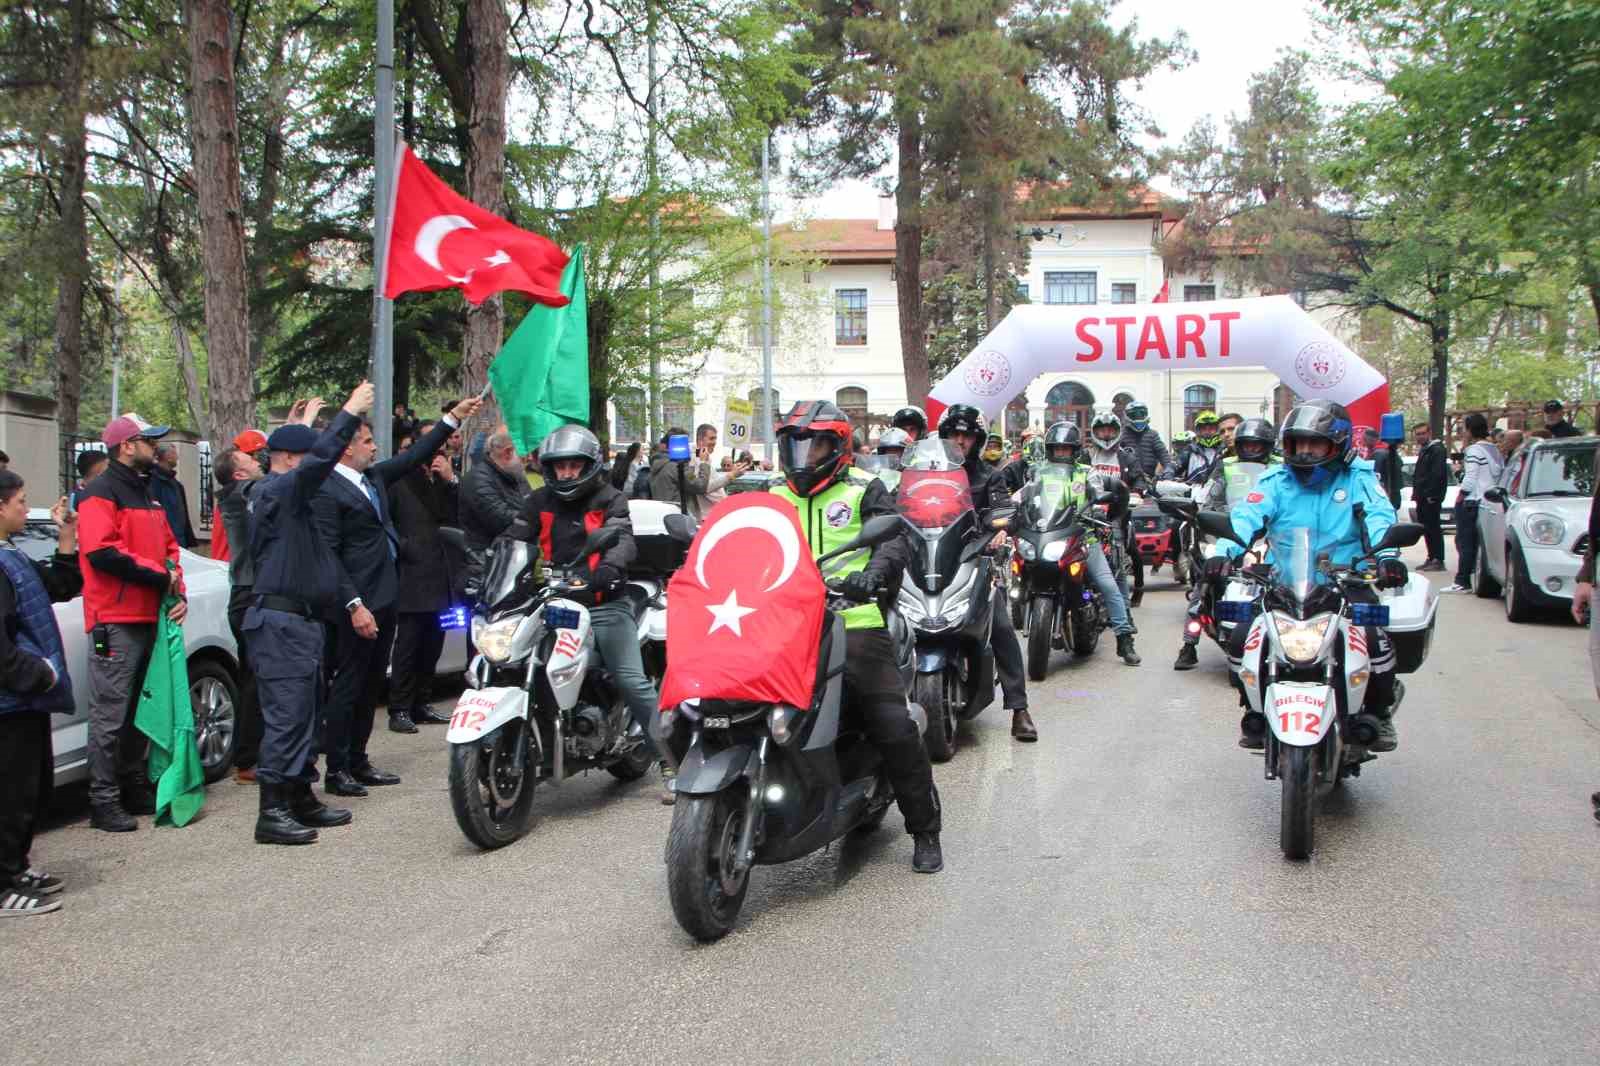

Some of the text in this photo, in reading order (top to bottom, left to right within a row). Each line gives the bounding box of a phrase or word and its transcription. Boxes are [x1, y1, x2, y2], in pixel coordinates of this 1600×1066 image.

[1075, 311, 1241, 363] START
[730, 423, 746, 437] 30
[555, 631, 581, 659] 112
[449, 710, 487, 732] 112
[1279, 711, 1321, 736] 112
